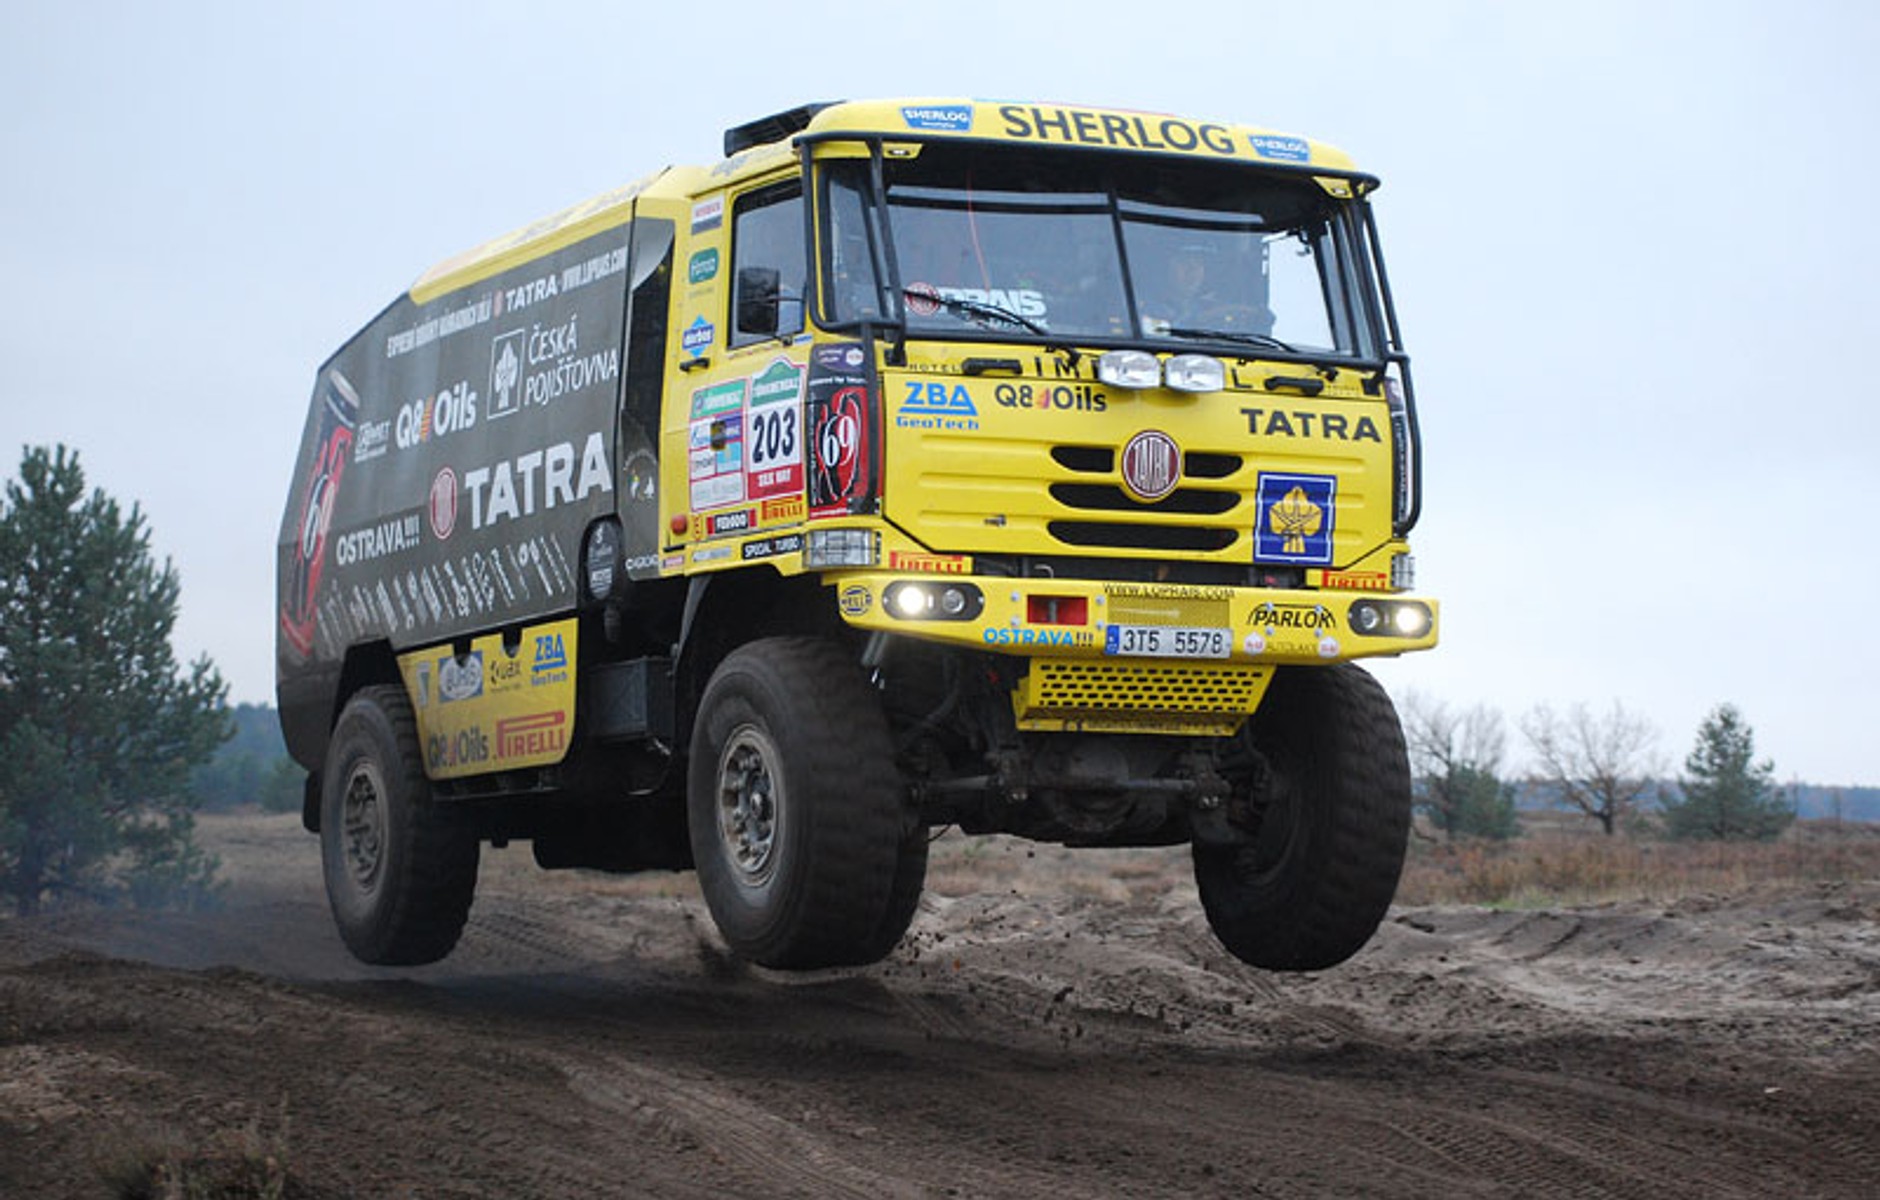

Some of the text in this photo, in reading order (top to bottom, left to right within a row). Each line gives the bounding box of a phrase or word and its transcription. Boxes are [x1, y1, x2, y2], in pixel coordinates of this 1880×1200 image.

[904, 109, 970, 122] SHERLOG
[999, 104, 1236, 154] SHERLOG
[505, 279, 559, 312] TATRA
[529, 313, 577, 366] ČESKÁ
[524, 347, 619, 406] POJIŠŤOVNA
[908, 363, 960, 374] HOTEL
[902, 381, 978, 414] ZBA
[995, 384, 1107, 412] Q8 Oils
[395, 399, 427, 449] Q8
[433, 380, 477, 437] Oils
[896, 415, 979, 431] GeoTech
[1240, 408, 1382, 442] TATRA
[753, 407, 797, 464] 203
[464, 431, 613, 530] TATRA
[761, 495, 803, 520] PIRELLI
[1253, 608, 1334, 629] PARLOK
[532, 633, 567, 671] ZBA
[1123, 629, 1160, 652] 3T5
[1175, 631, 1224, 654] 5578
[496, 710, 565, 760] PIRELLI
